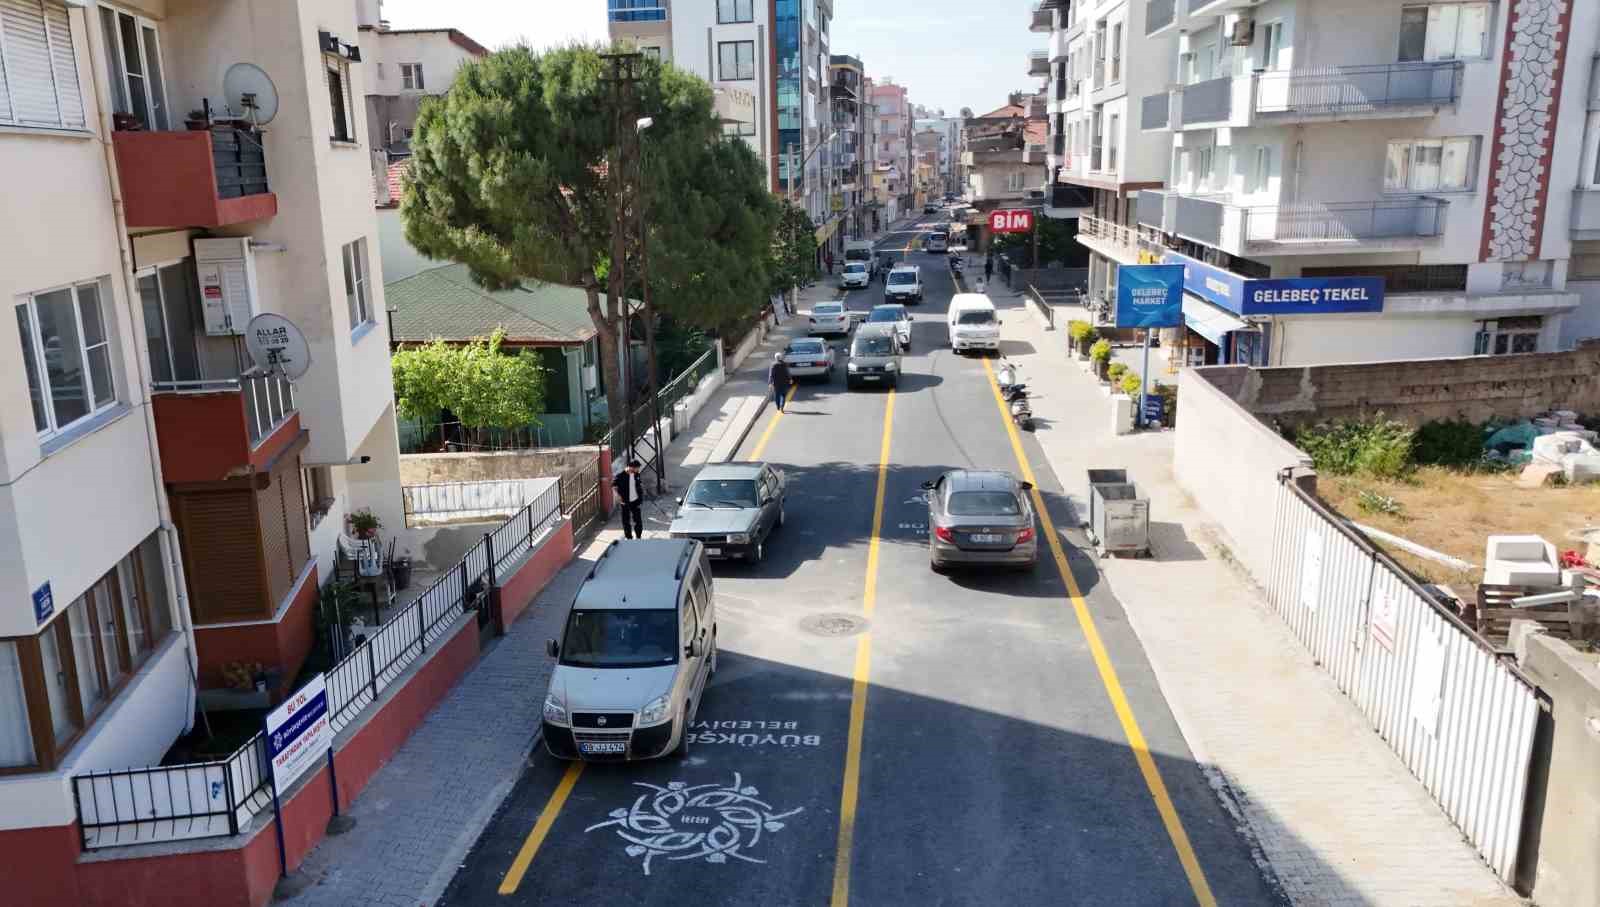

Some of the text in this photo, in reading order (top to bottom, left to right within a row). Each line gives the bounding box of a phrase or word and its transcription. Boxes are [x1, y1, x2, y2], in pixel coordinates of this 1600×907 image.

[1132, 297, 1167, 305] MARKET
[1253, 288, 1369, 305] GELEBEÇ TEKEL
